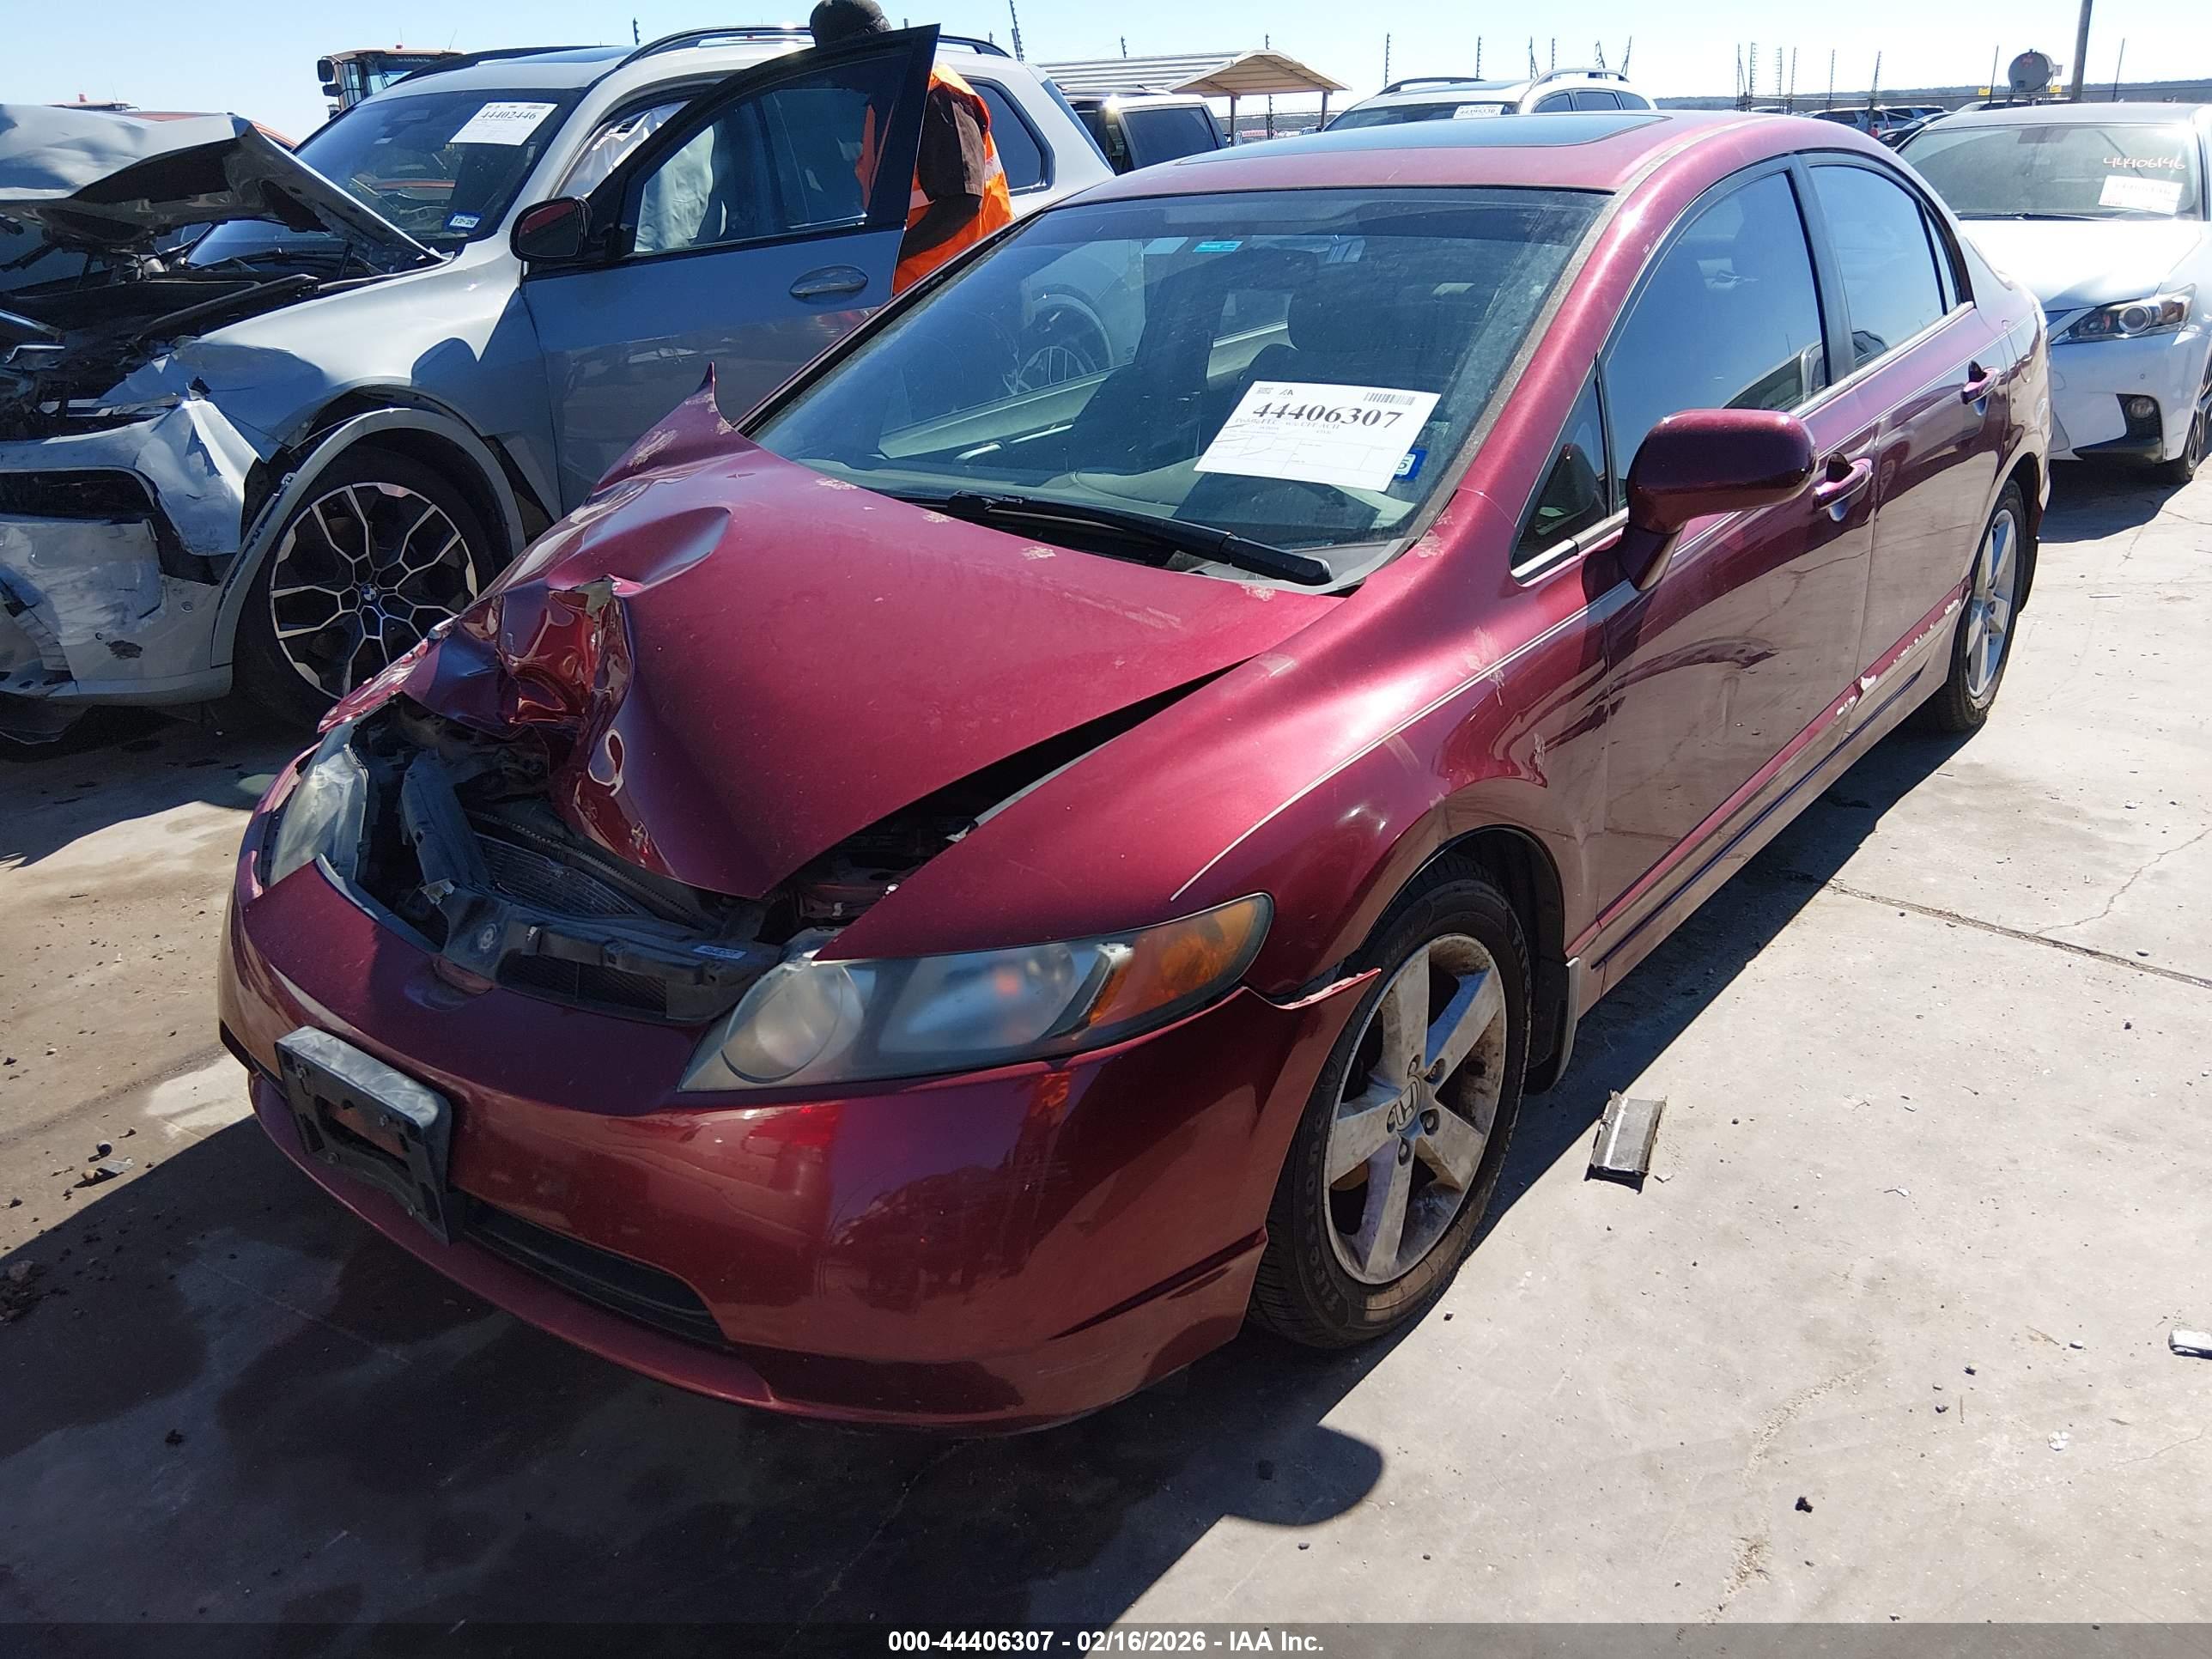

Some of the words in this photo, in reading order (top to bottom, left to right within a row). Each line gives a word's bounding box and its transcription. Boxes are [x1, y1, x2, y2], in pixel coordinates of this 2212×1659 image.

[481, 111, 537, 120] 44402446
[2103, 157, 2185, 170] 44406146
[1252, 402, 1404, 428] 44406307
